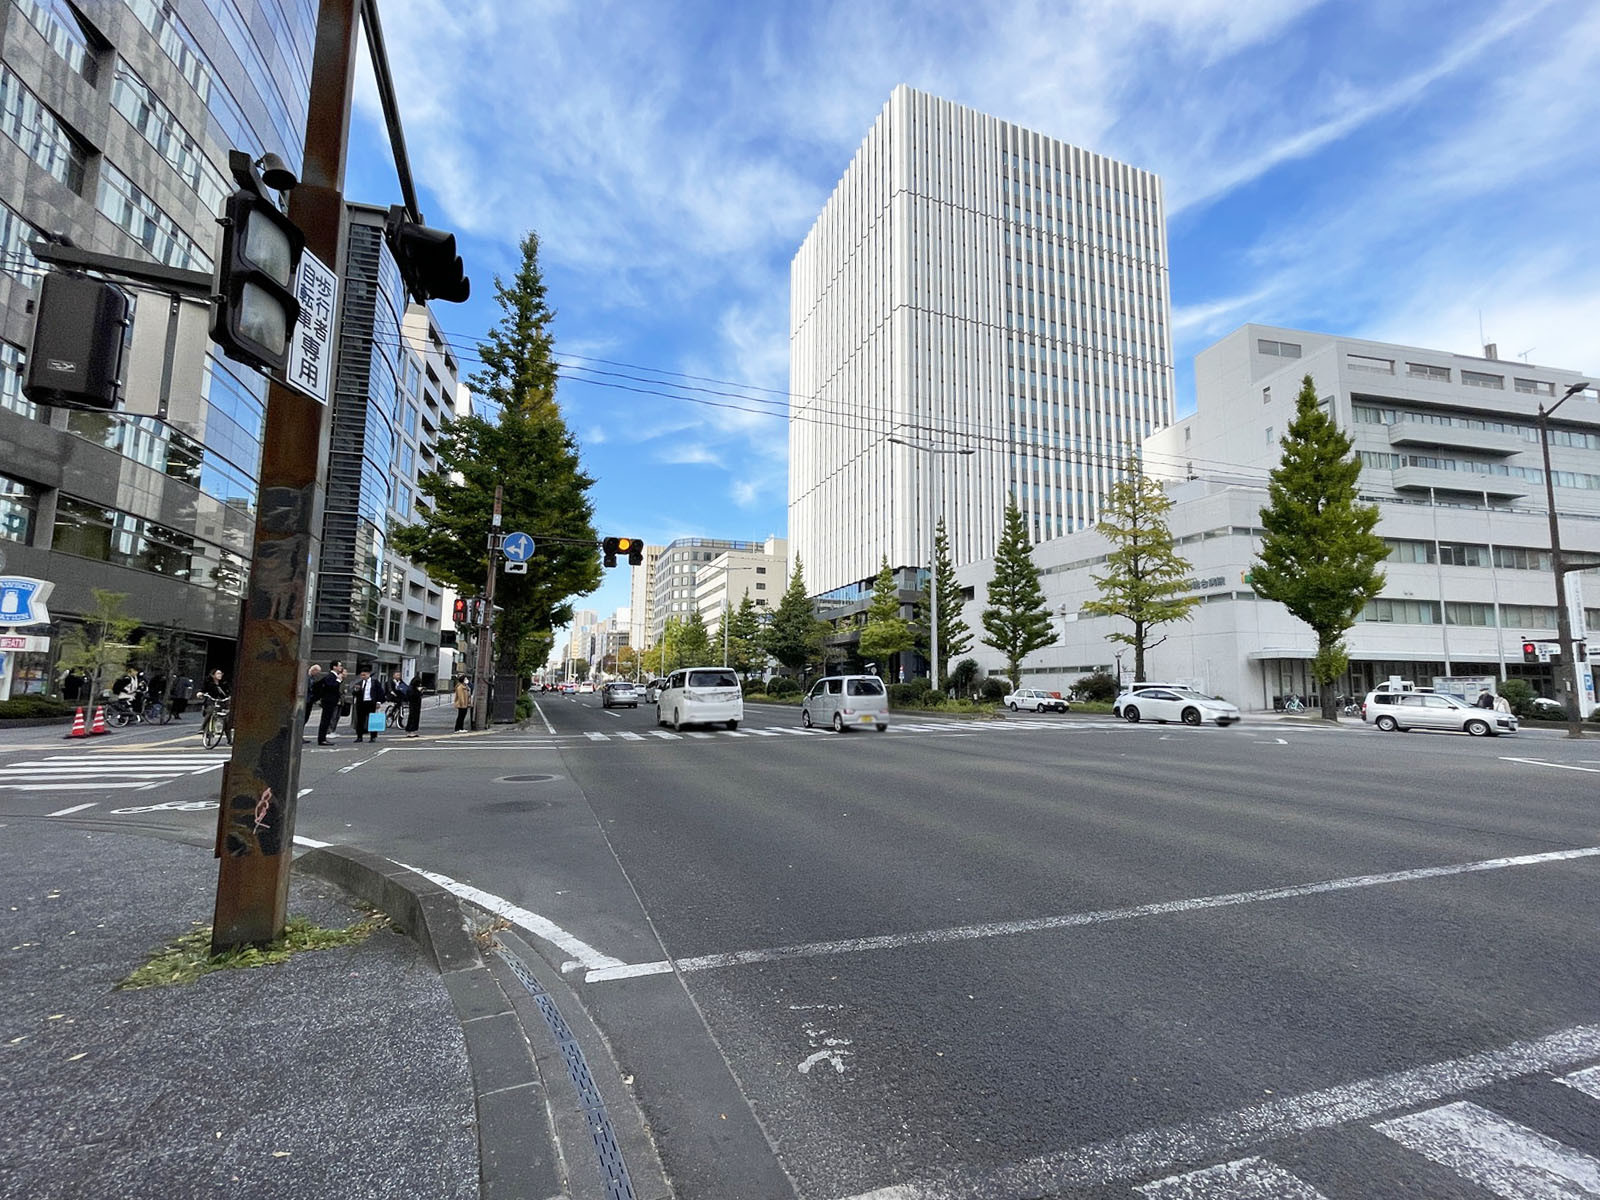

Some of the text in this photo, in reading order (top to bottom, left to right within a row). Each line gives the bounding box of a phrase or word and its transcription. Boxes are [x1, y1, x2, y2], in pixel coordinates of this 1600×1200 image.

[298, 263, 315, 329] 自転車
[314, 275, 332, 342] 歩行者
[299, 332, 320, 387] 専用
